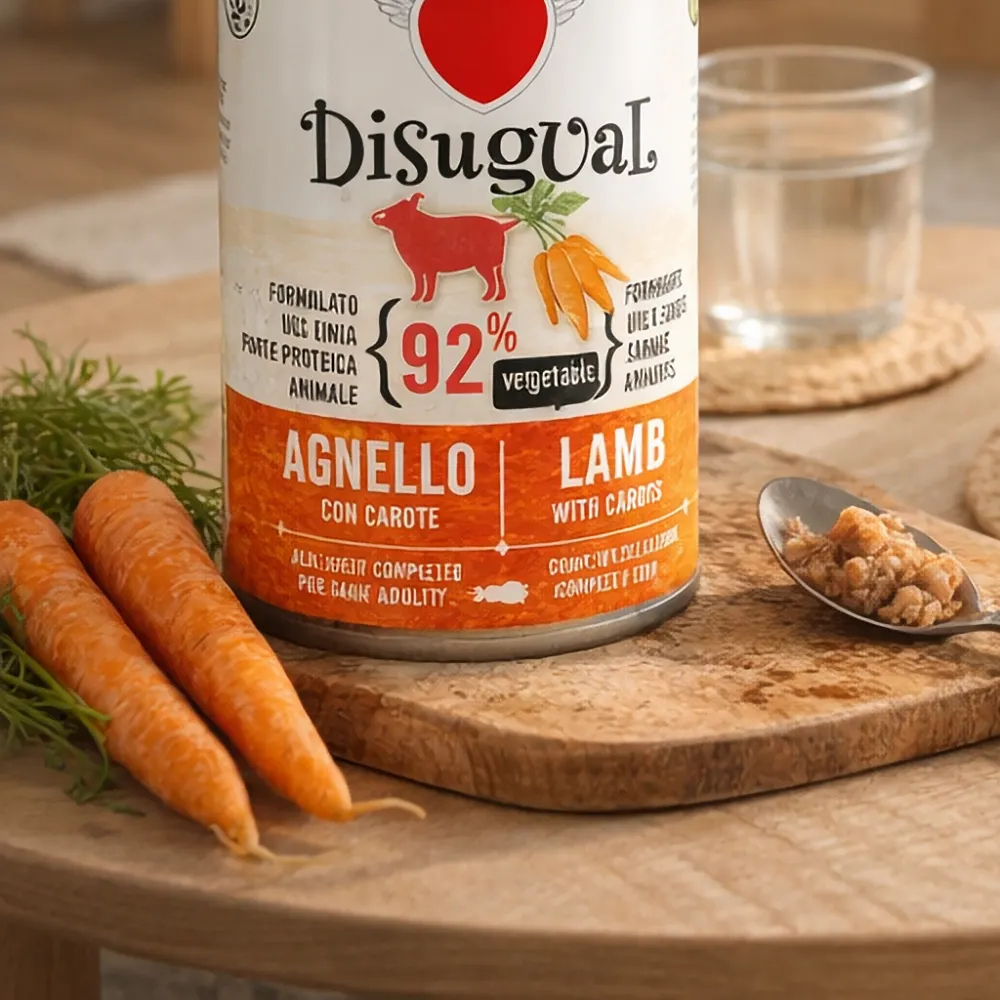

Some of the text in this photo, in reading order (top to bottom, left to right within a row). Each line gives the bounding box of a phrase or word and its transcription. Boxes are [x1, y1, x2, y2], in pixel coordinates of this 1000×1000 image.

[289, 377, 358, 405] ANIMALE
[282, 429, 475, 496] AGNELLO
[560, 418, 665, 489] LAMB
[321, 498, 440, 529] CON CAROTE
